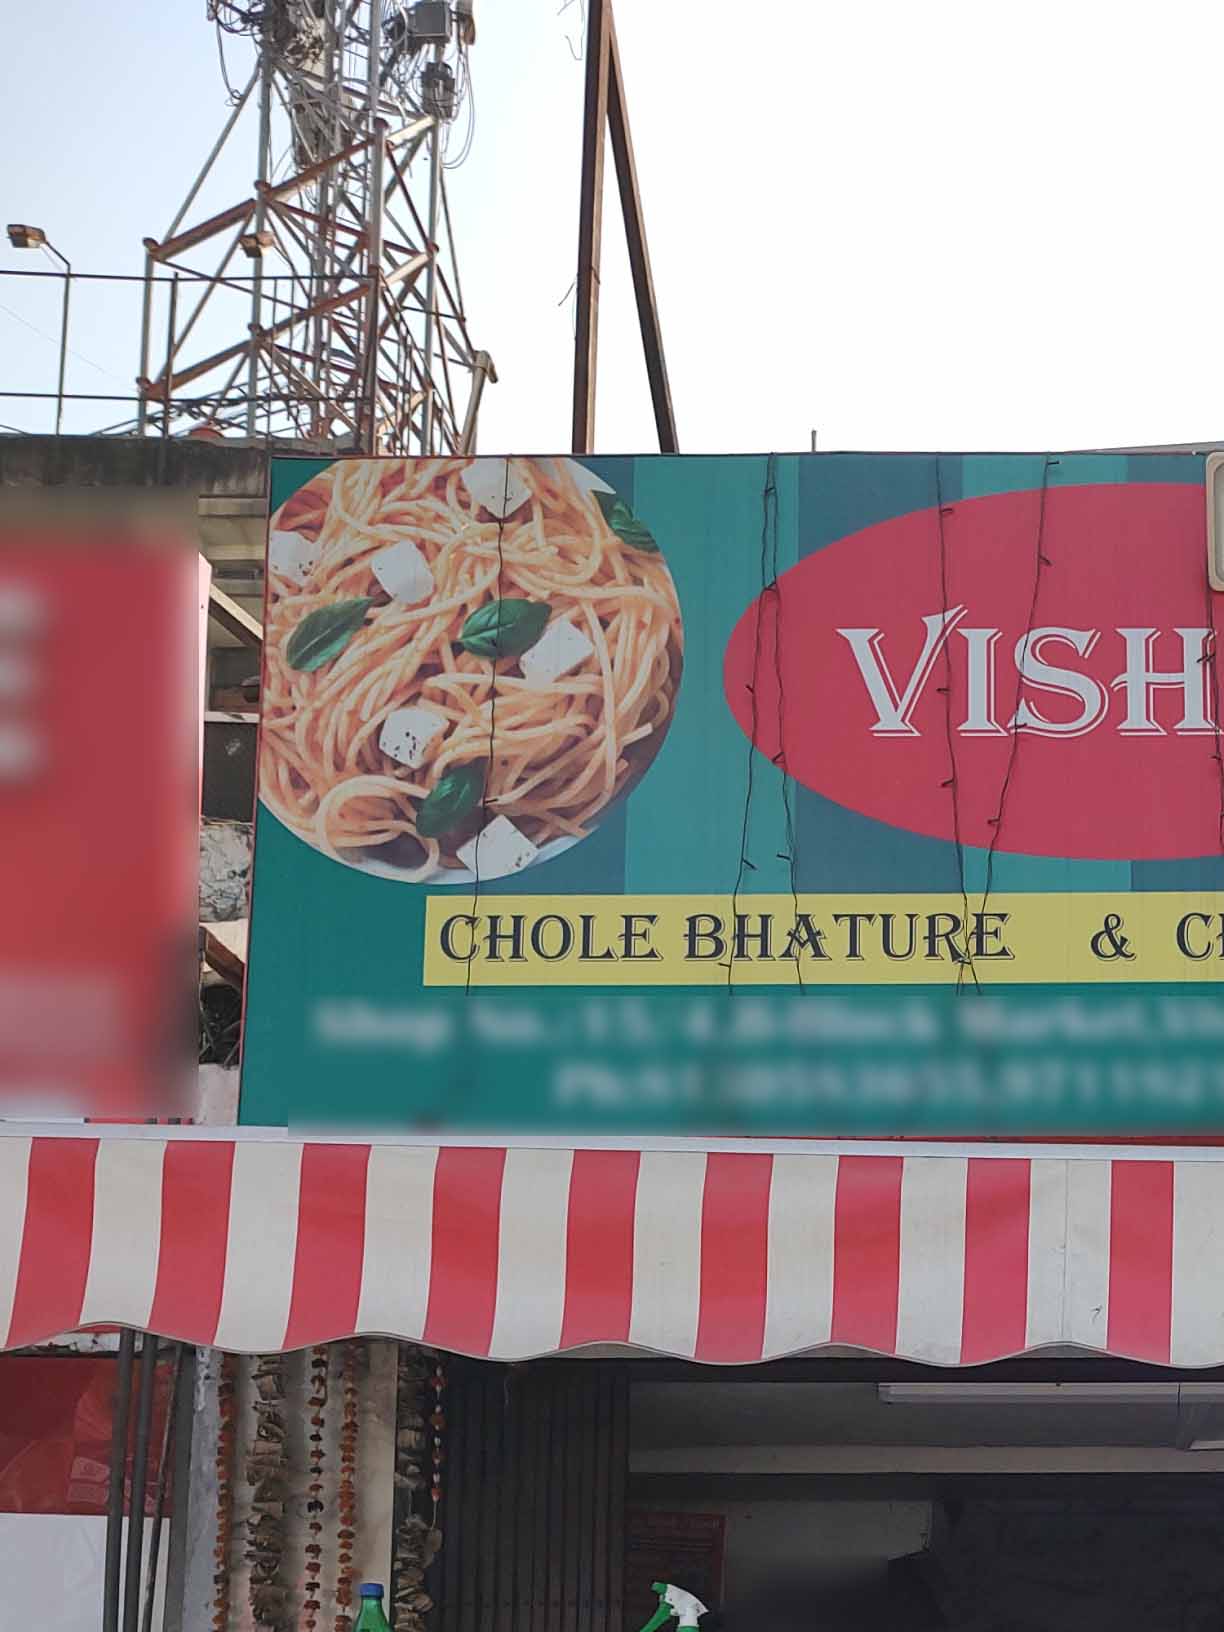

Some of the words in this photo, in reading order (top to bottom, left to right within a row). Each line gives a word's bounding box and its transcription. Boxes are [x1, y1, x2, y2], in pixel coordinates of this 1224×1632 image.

[439, 914, 661, 962] CHOLE
[683, 912, 1016, 962] BHATURE
[1090, 913, 1136, 962] &
